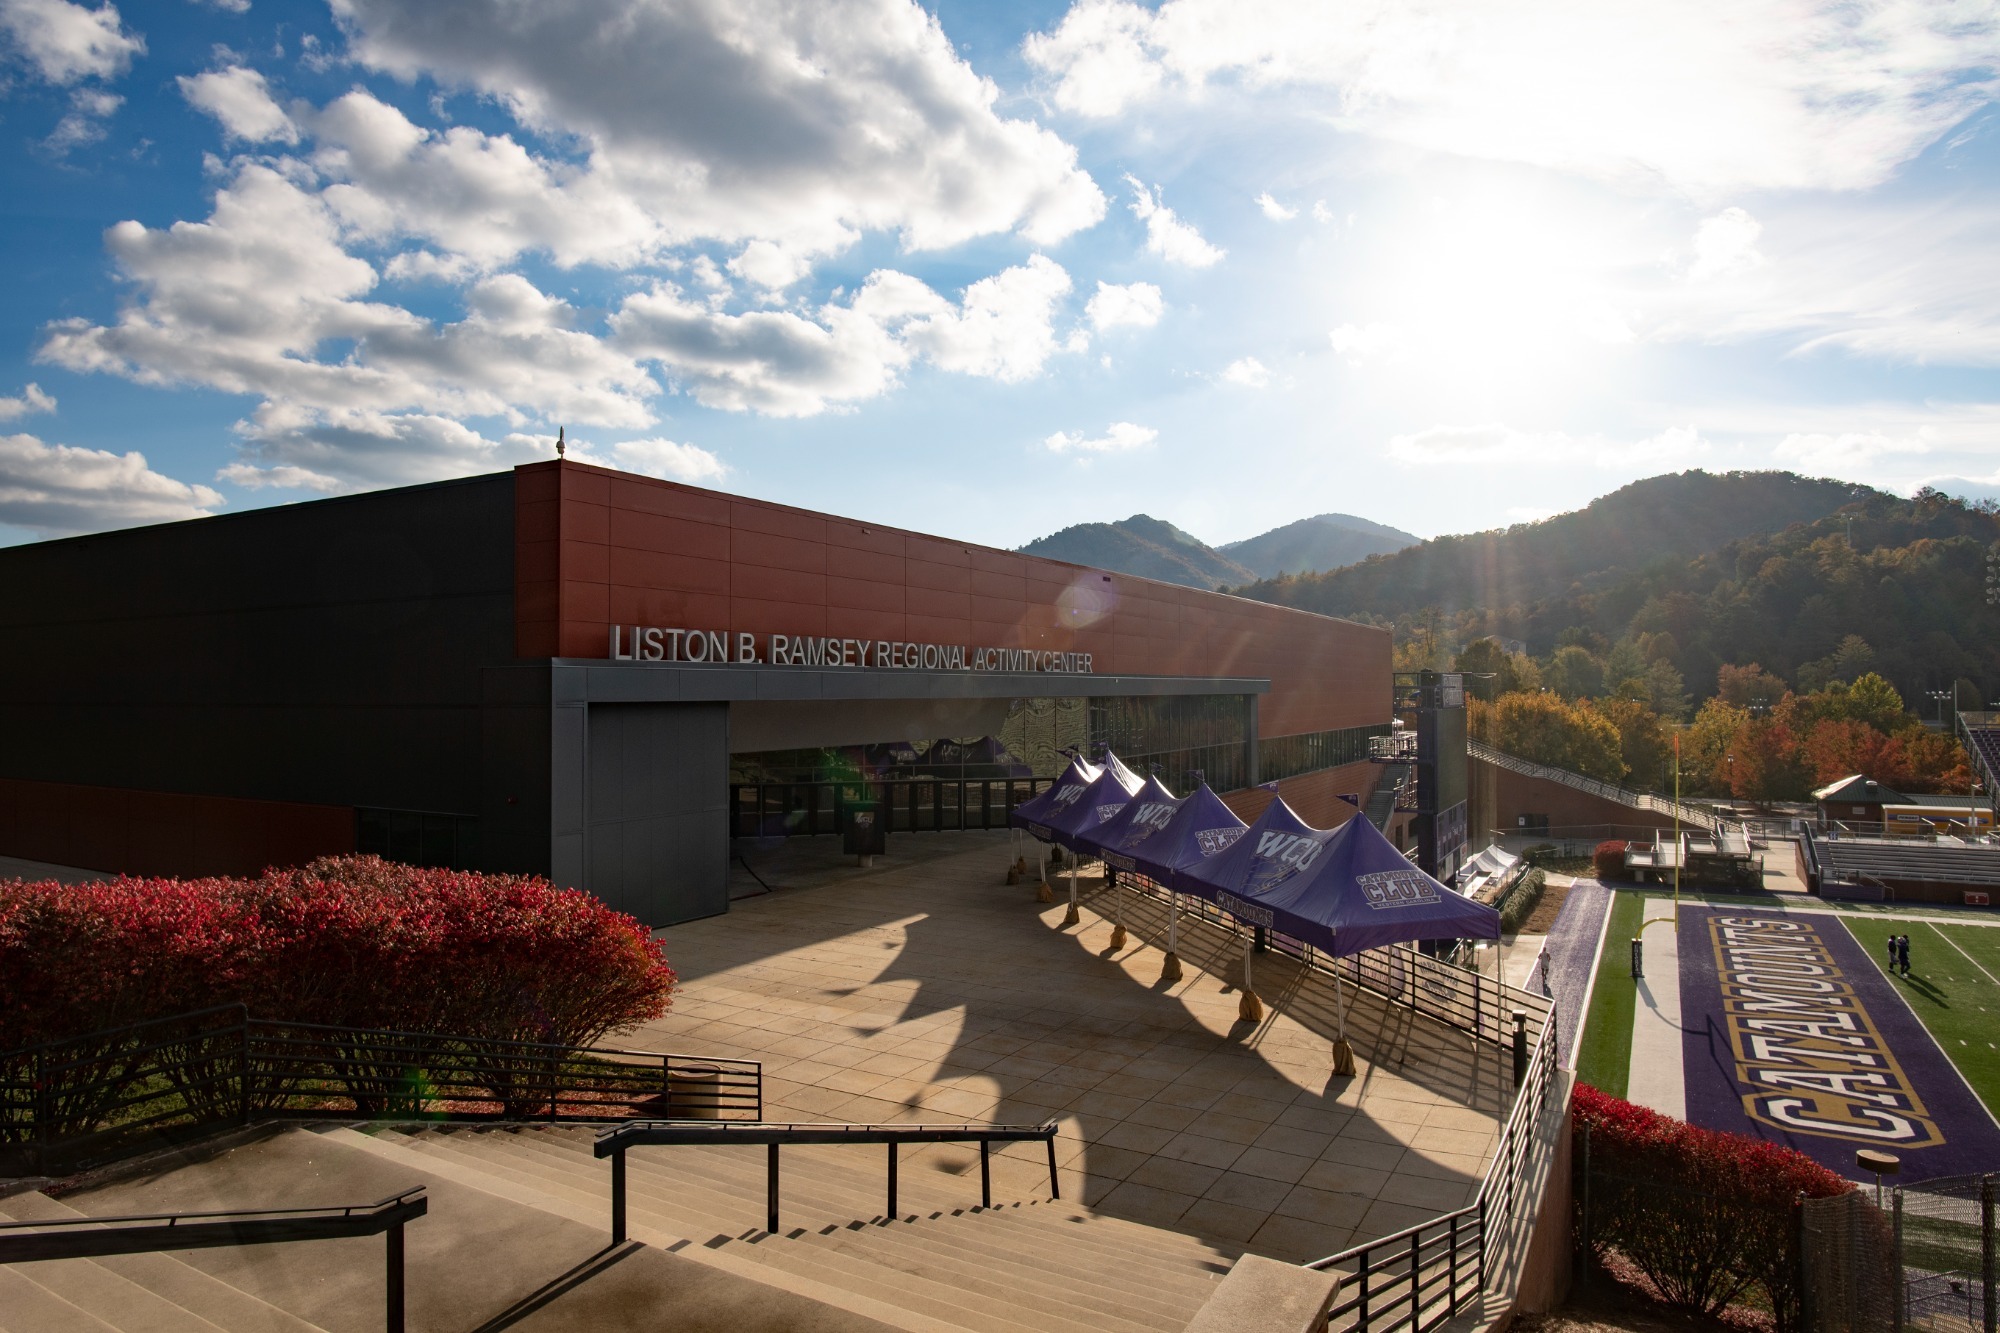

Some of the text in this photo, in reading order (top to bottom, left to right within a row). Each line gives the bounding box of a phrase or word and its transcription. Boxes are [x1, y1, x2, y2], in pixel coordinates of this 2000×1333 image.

[615, 625, 1094, 673] LISTON B. RAMSEY REGIONAL ACTIVITY CENTER
[1256, 831, 1323, 872] WCU
[1356, 870, 1425, 885] CATAMOUNT
[1362, 878, 1436, 902] CLUB
[1376, 897, 1436, 908] WESTERN CAROLINA
[1717, 917, 1918, 1140] CATAMOUNTS
